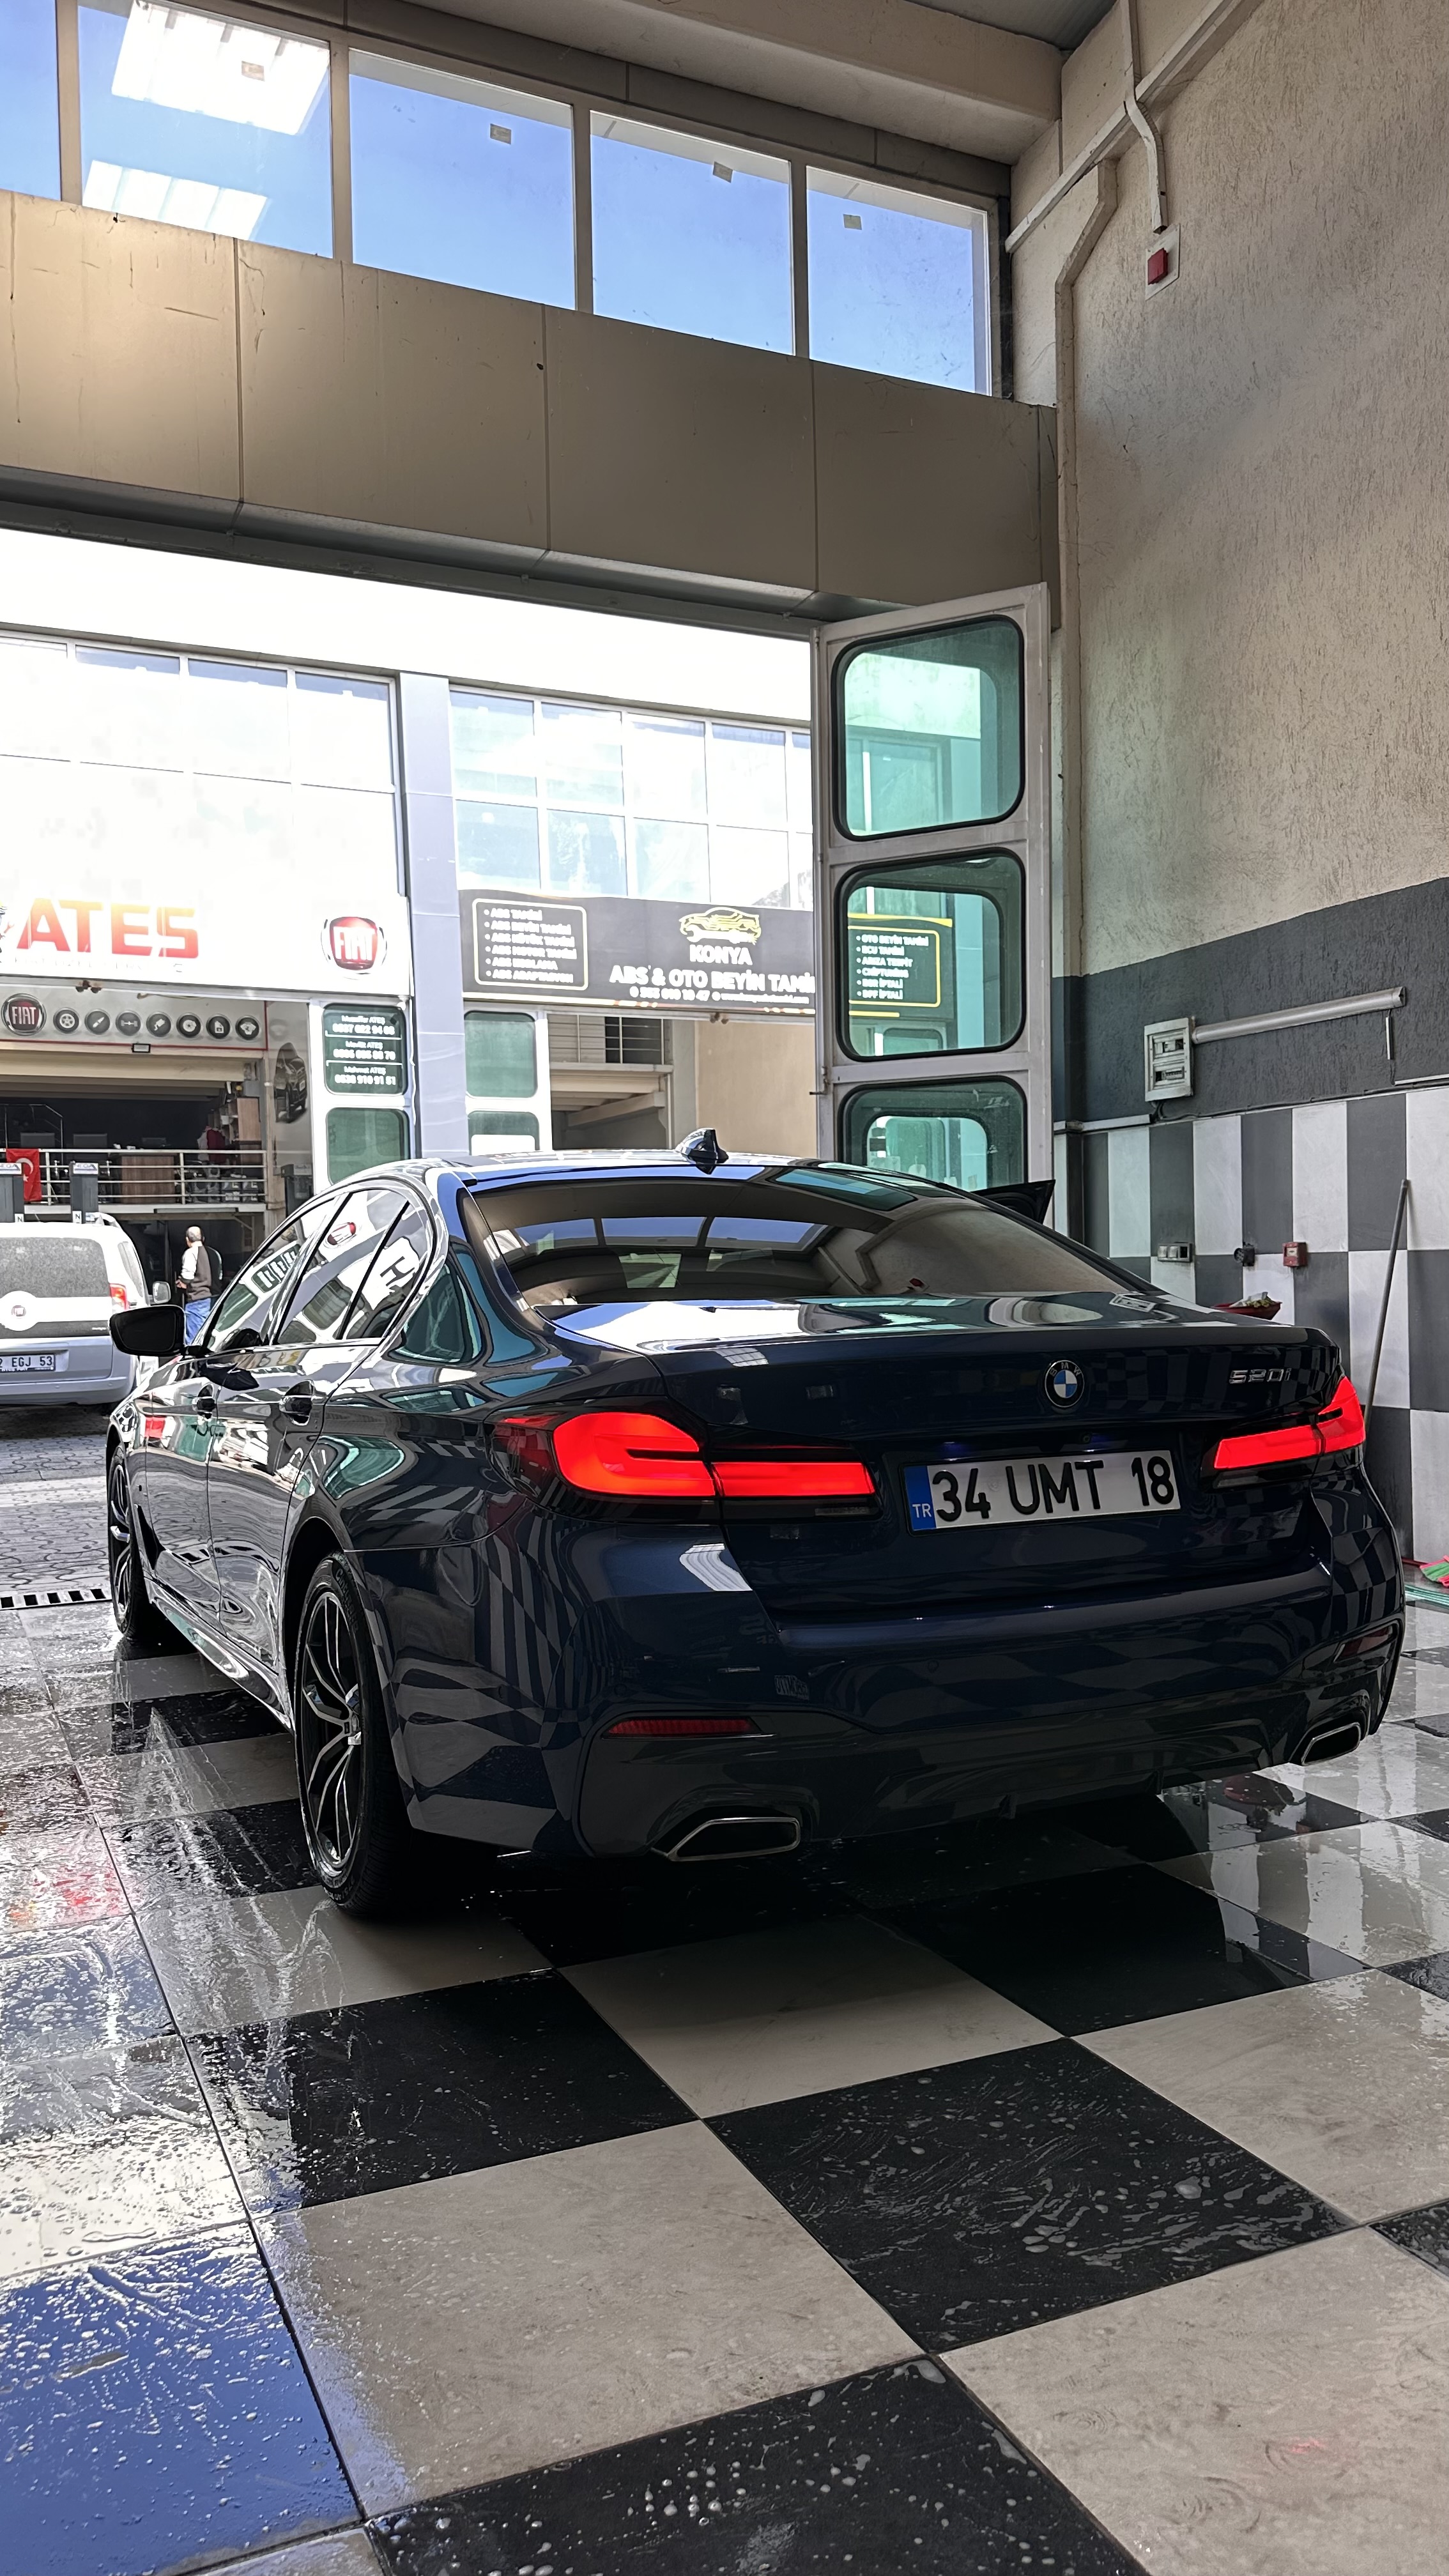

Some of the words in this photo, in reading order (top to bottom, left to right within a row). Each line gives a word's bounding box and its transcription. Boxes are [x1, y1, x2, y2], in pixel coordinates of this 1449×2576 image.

[333, 926, 376, 961] FIAT
[689, 944, 753, 965] KONYA
[651, 967, 666, 986] &
[668, 969, 708, 988] OTO
[711, 969, 765, 991] BEYİN
[12, 1006, 36, 1025] FIAT
[12, 1356, 31, 1367] EGJ
[40, 1356, 52, 1366] 53
[1049, 1361, 1082, 1377] BMW
[1229, 1367, 1292, 1384] 520i
[932, 1468, 991, 1522] 34
[1005, 1460, 1104, 1515] UMT
[1131, 1455, 1174, 1506] 18
[912, 1503, 931, 1519] TR
